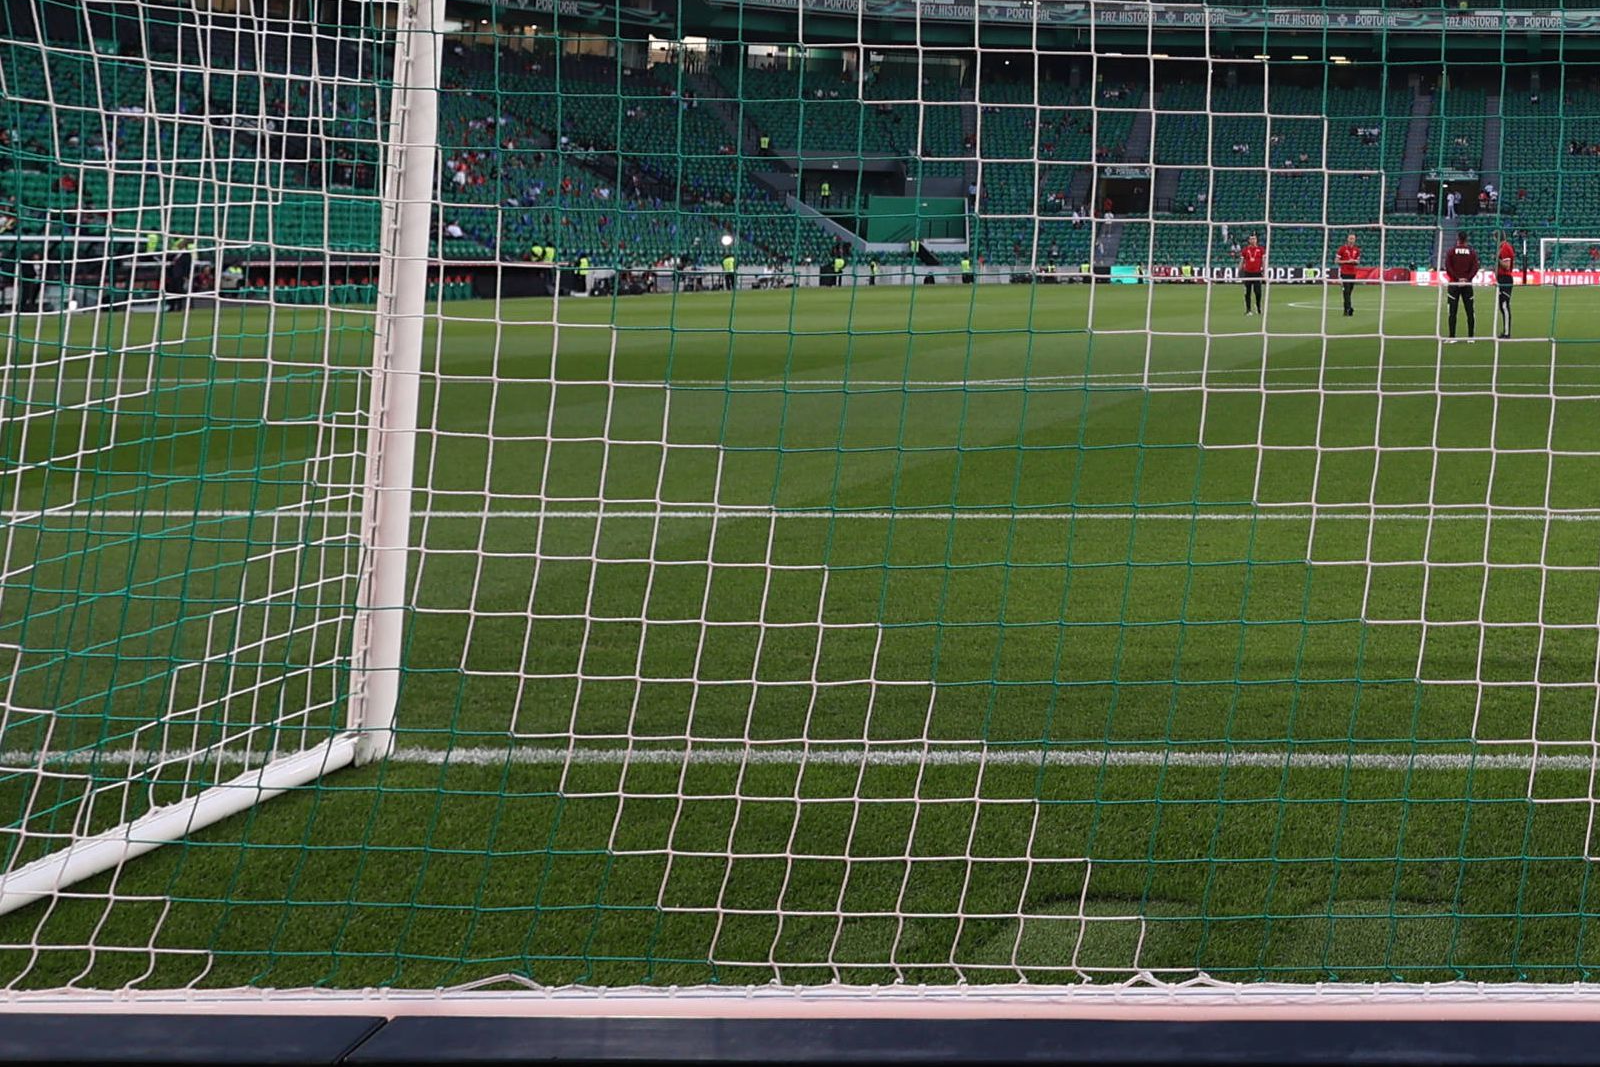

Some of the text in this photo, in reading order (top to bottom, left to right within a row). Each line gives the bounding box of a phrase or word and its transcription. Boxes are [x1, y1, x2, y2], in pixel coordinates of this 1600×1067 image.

[1184, 12, 1227, 24] PORTGAL
[1274, 13, 1290, 26] FAZ
[1355, 15, 1399, 27] PORTUAL
[1444, 16, 1460, 27] FAZ
[1524, 16, 1563, 28] PORTUGA
[1544, 275, 1594, 285] PORTUGAL
